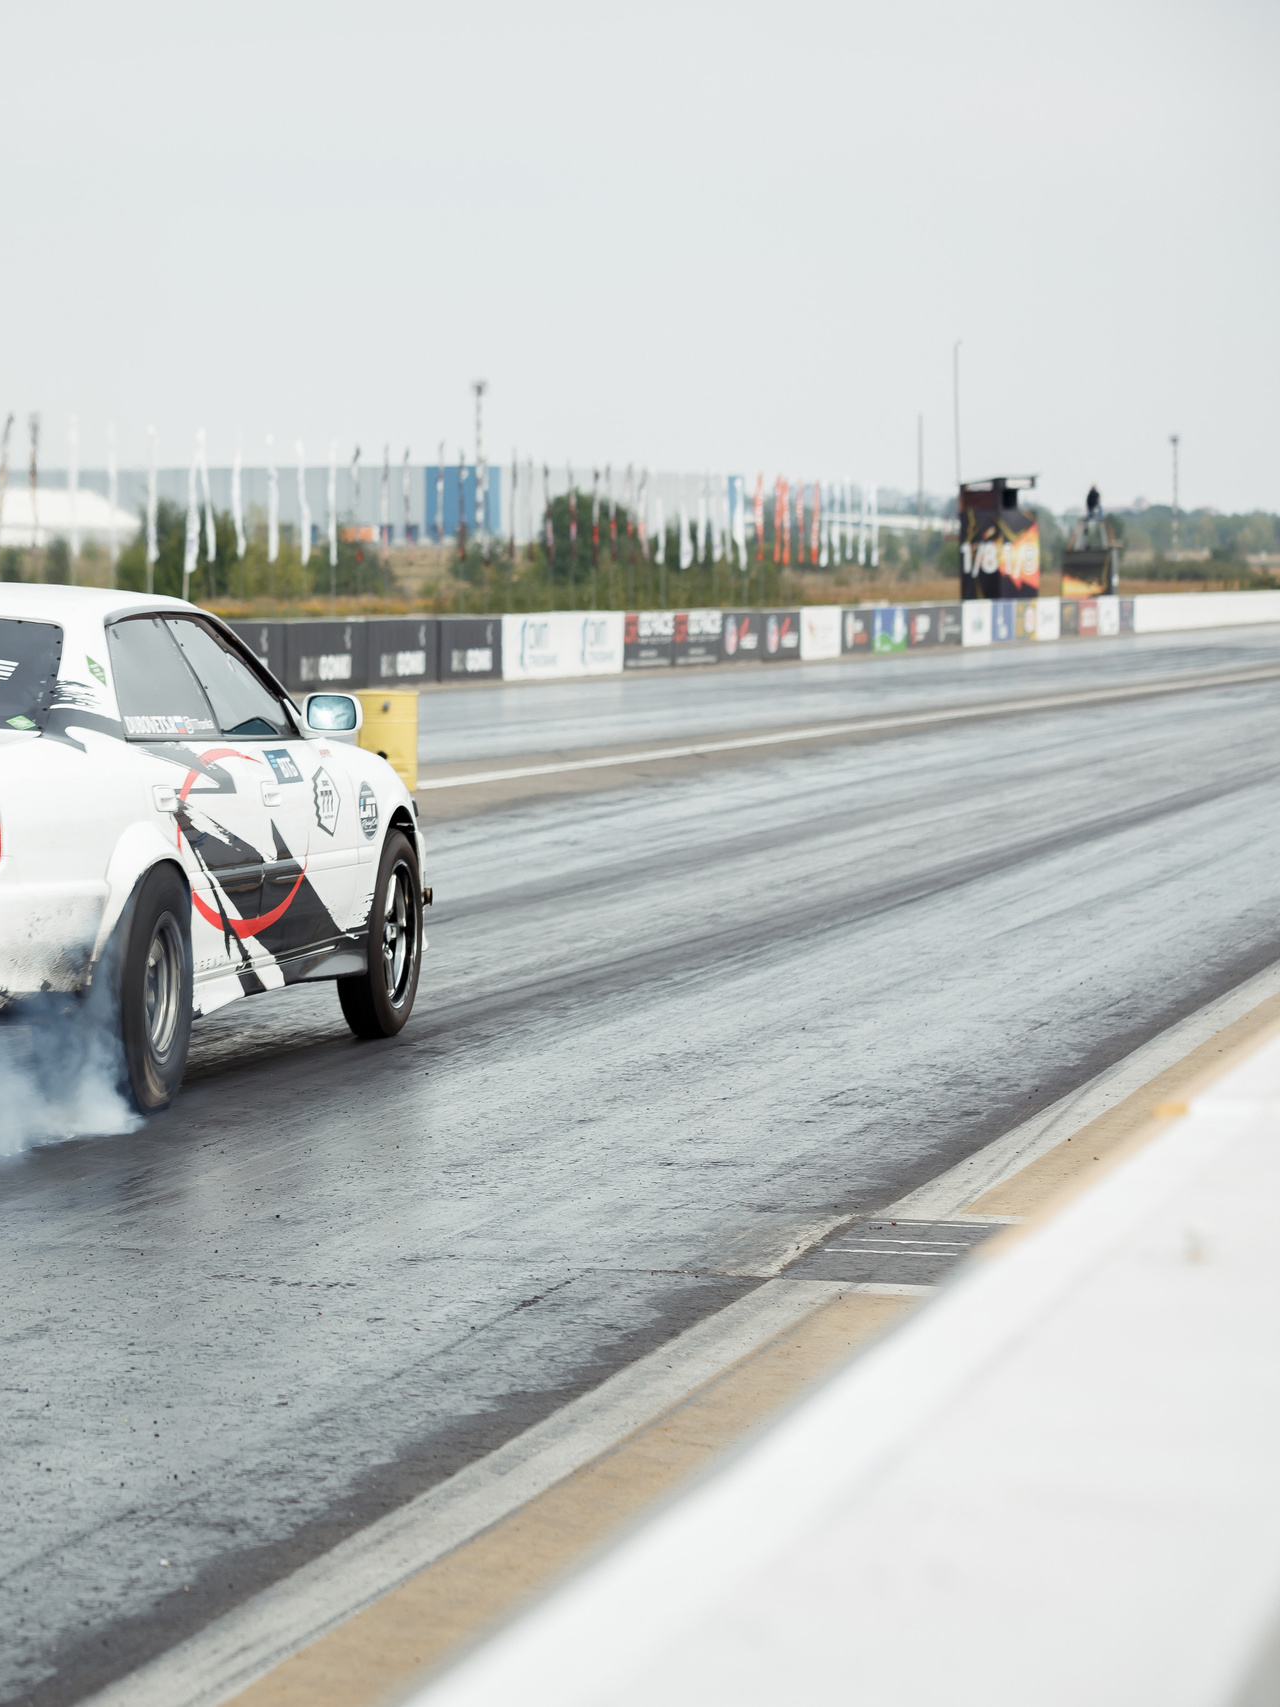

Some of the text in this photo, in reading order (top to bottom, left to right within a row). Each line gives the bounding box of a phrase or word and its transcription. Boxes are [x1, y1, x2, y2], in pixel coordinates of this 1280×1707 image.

[961, 541, 999, 579] 1/8
[1002, 542, 1037, 578] 1/8
[276, 757, 299, 779] ВТБ
